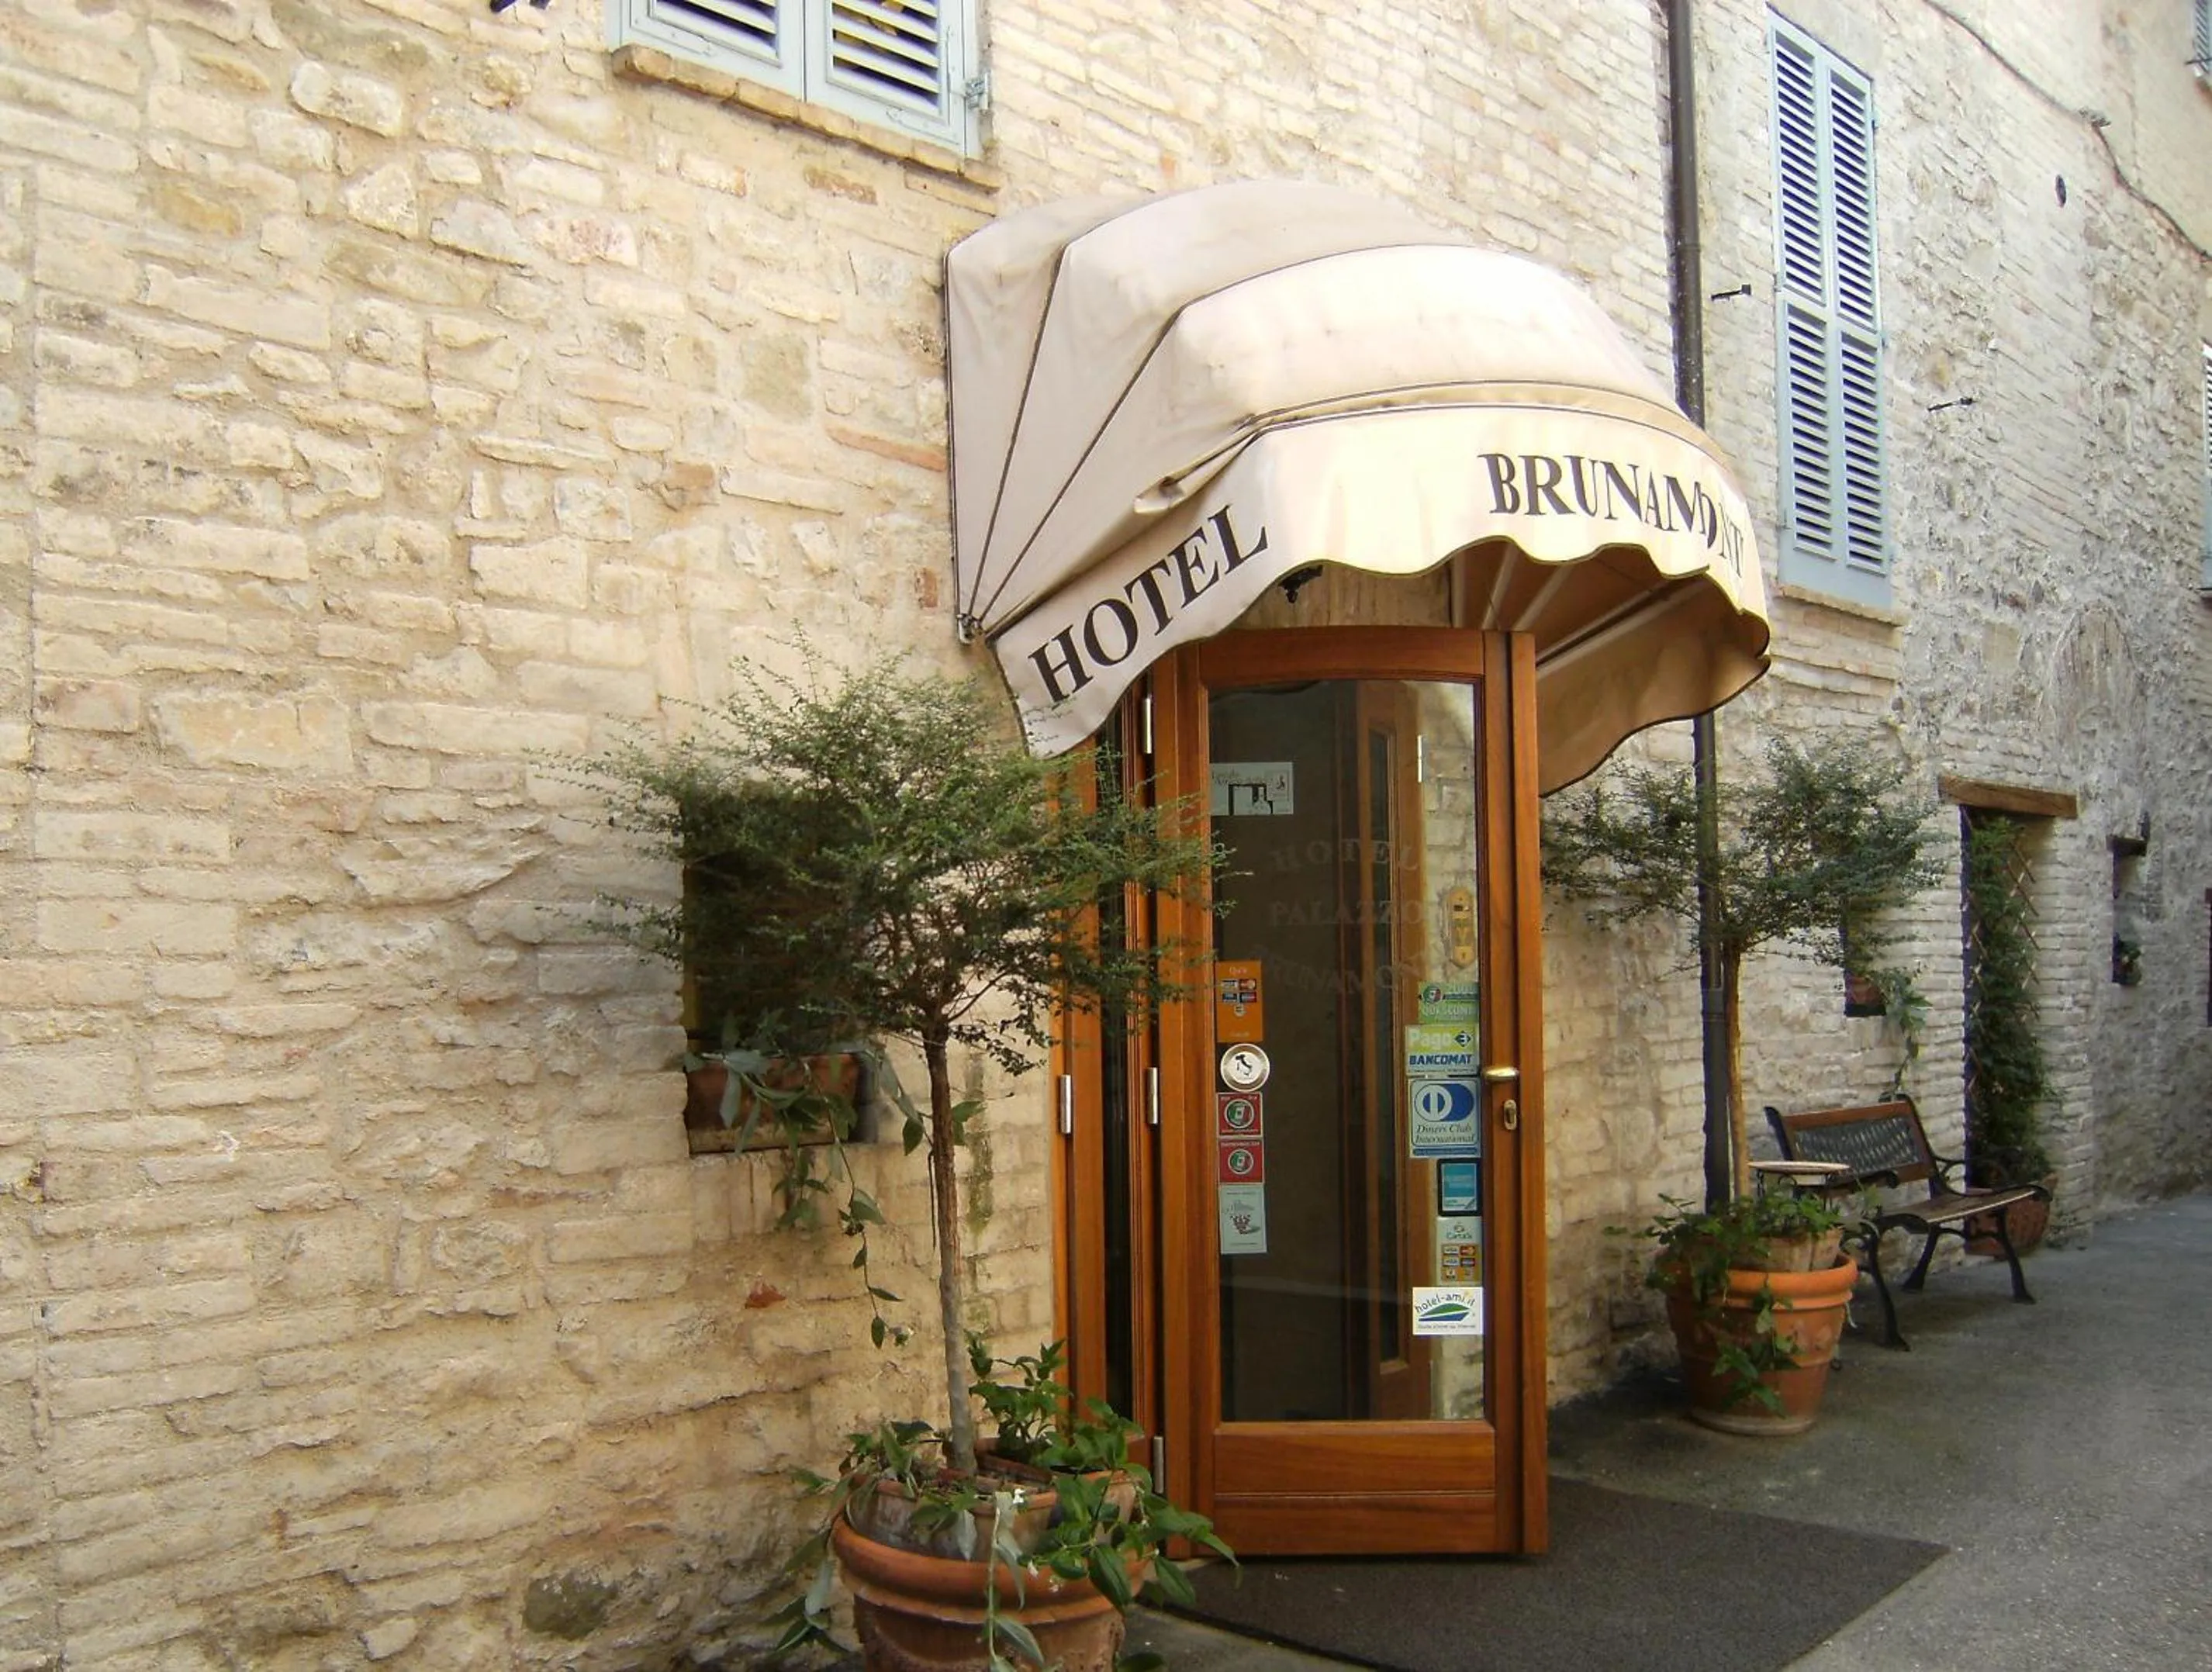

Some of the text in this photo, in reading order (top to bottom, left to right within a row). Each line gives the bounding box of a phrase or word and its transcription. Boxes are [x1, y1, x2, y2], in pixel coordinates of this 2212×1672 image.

[1028, 504, 1269, 703] HOTEL
[1270, 838, 1419, 872] HOTEL
[1270, 899, 1421, 927] PALAZZO
[1408, 1028, 1451, 1050] Pago
[1409, 1054, 1472, 1065] BANCOMAT
[1449, 1121, 1472, 1133] Club
